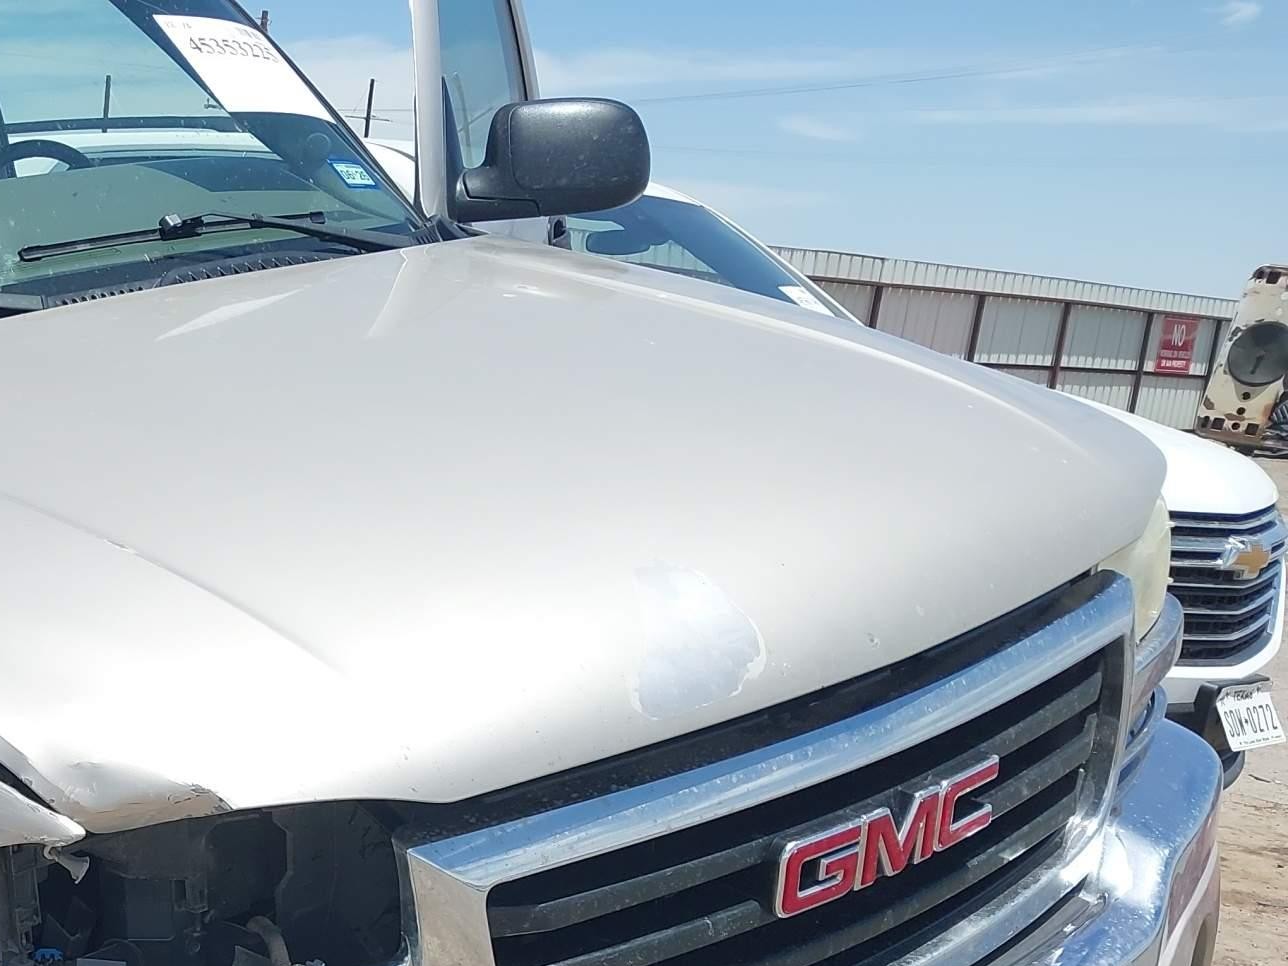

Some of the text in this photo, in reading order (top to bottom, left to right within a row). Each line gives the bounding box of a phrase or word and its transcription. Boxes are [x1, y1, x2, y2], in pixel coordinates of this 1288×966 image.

[189, 36, 280, 64] 45353225
[1172, 324, 1186, 347] NO
[776, 754, 1000, 919] GMC
